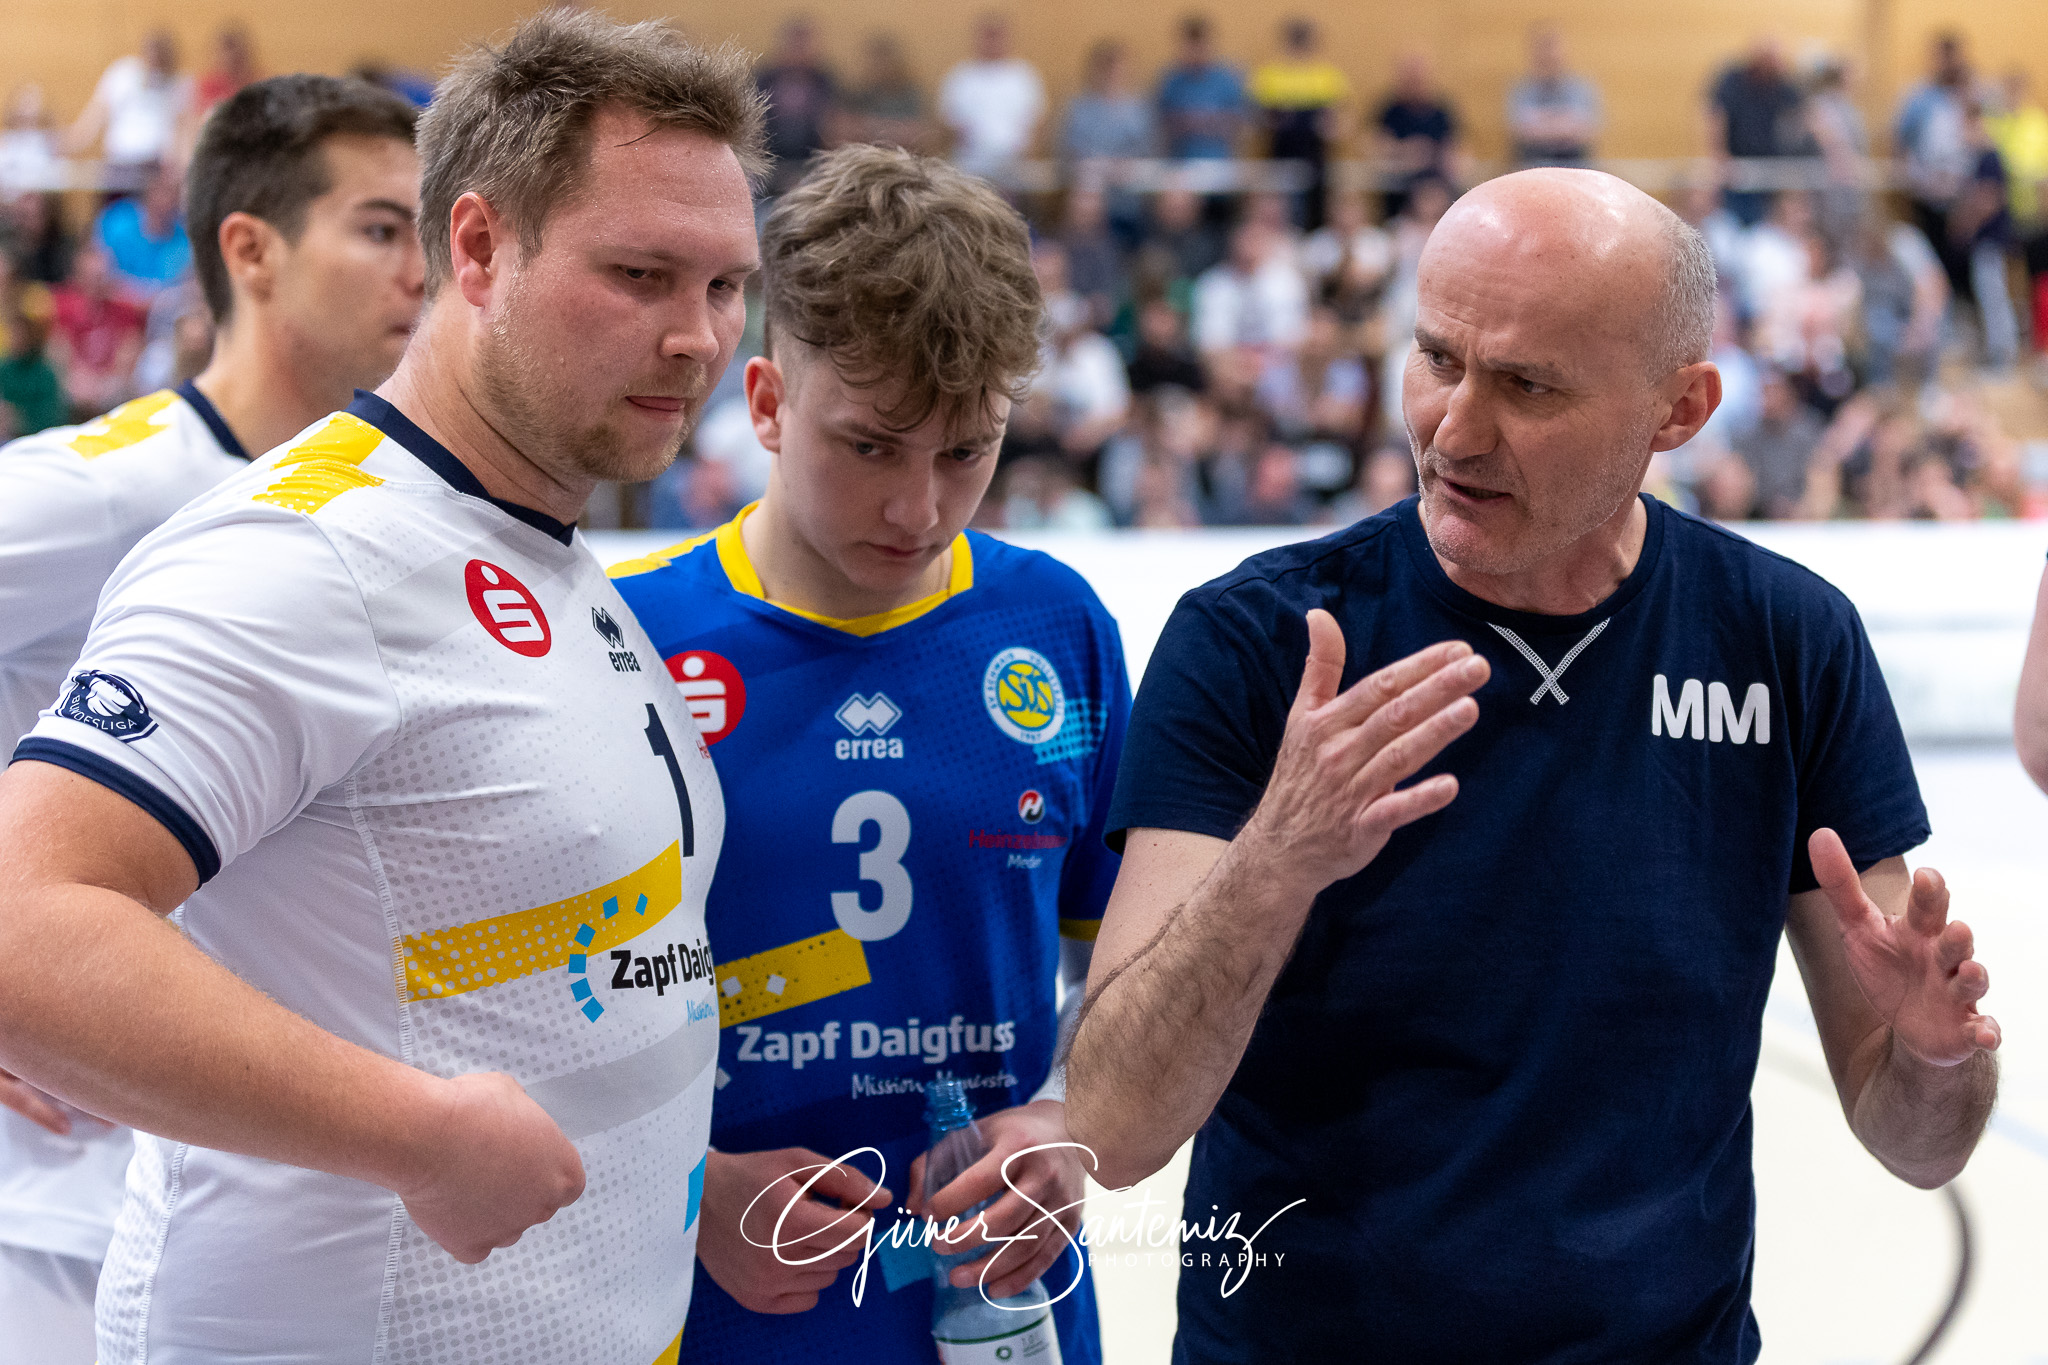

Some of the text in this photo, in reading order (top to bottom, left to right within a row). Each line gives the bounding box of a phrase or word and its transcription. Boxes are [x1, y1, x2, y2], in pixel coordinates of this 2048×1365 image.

[608, 651, 642, 673] errea
[1651, 673, 1770, 745] MM
[835, 737, 904, 760] errea
[643, 703, 695, 857] 1
[830, 790, 913, 942] 3
[610, 943, 678, 996] Zapf
[736, 1015, 1016, 1069] Zapf Daigfuss
[852, 1073, 925, 1100] Mission
